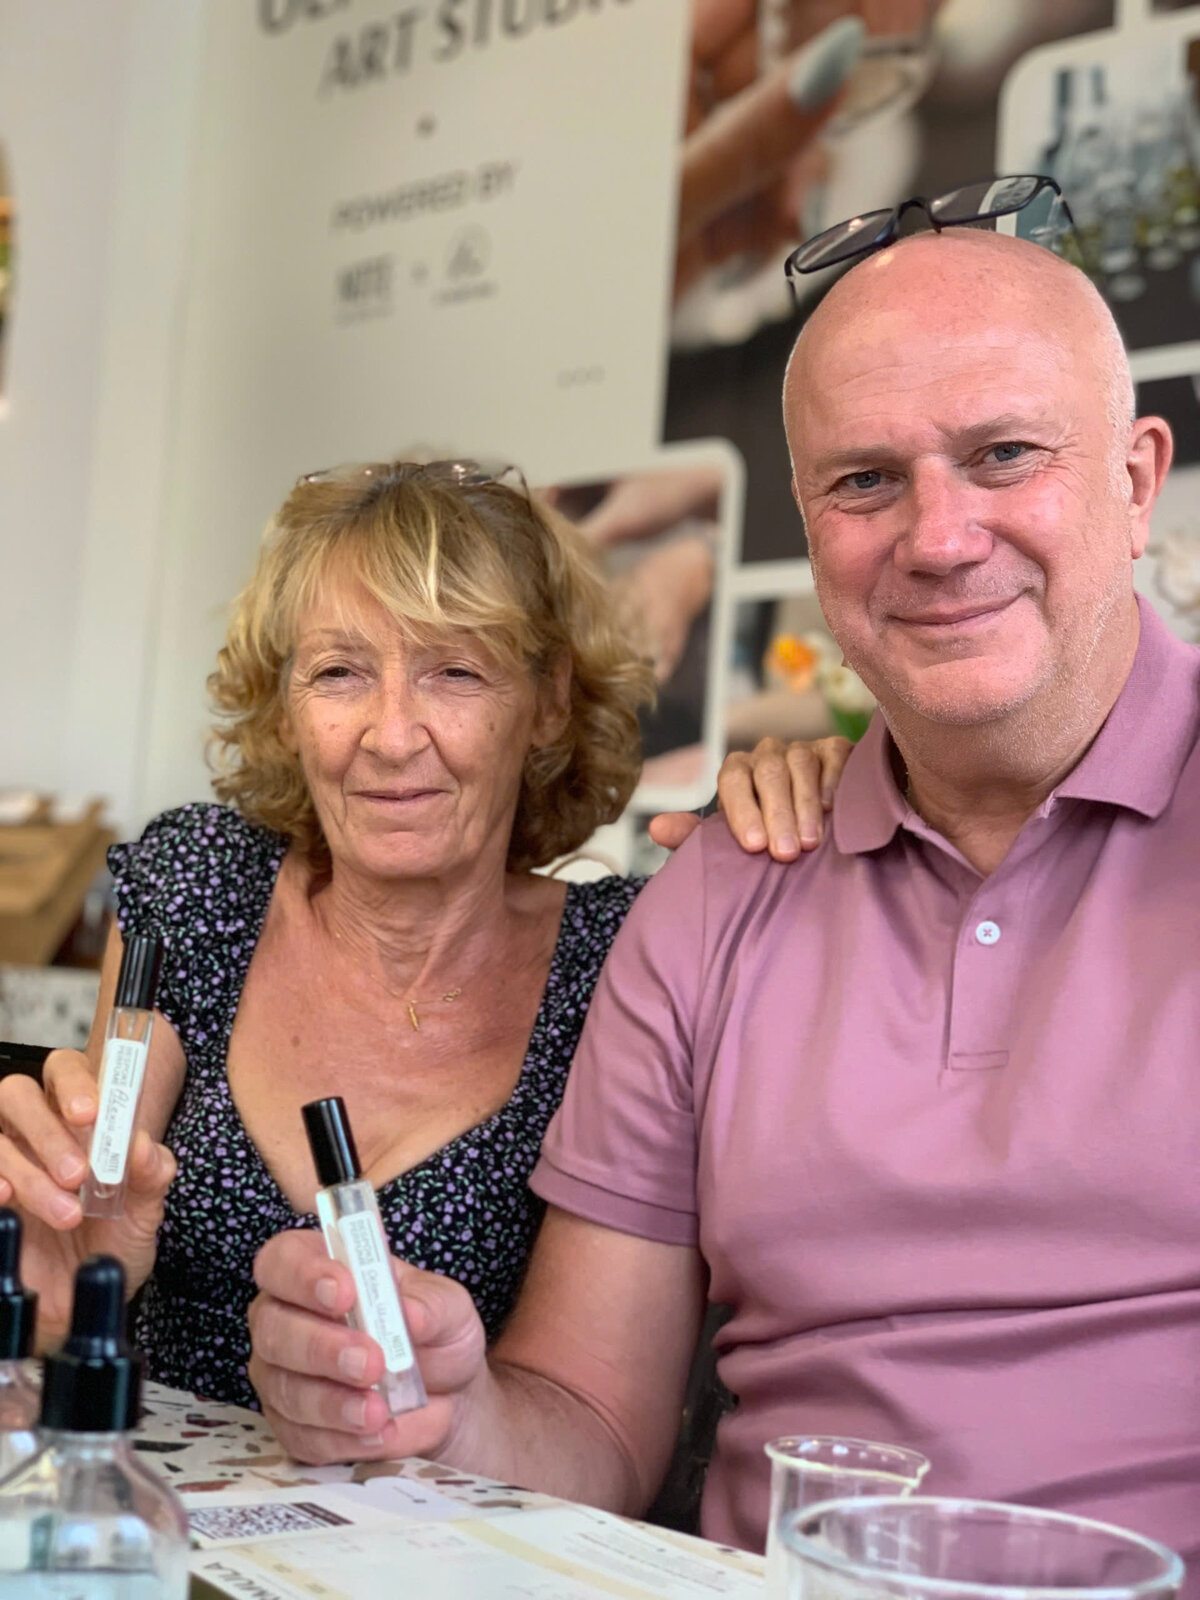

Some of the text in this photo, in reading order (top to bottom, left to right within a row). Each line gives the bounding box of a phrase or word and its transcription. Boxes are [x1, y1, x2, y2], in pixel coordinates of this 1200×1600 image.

[317, 8, 416, 98] ART
[331, 160, 518, 233] POWERED BY
